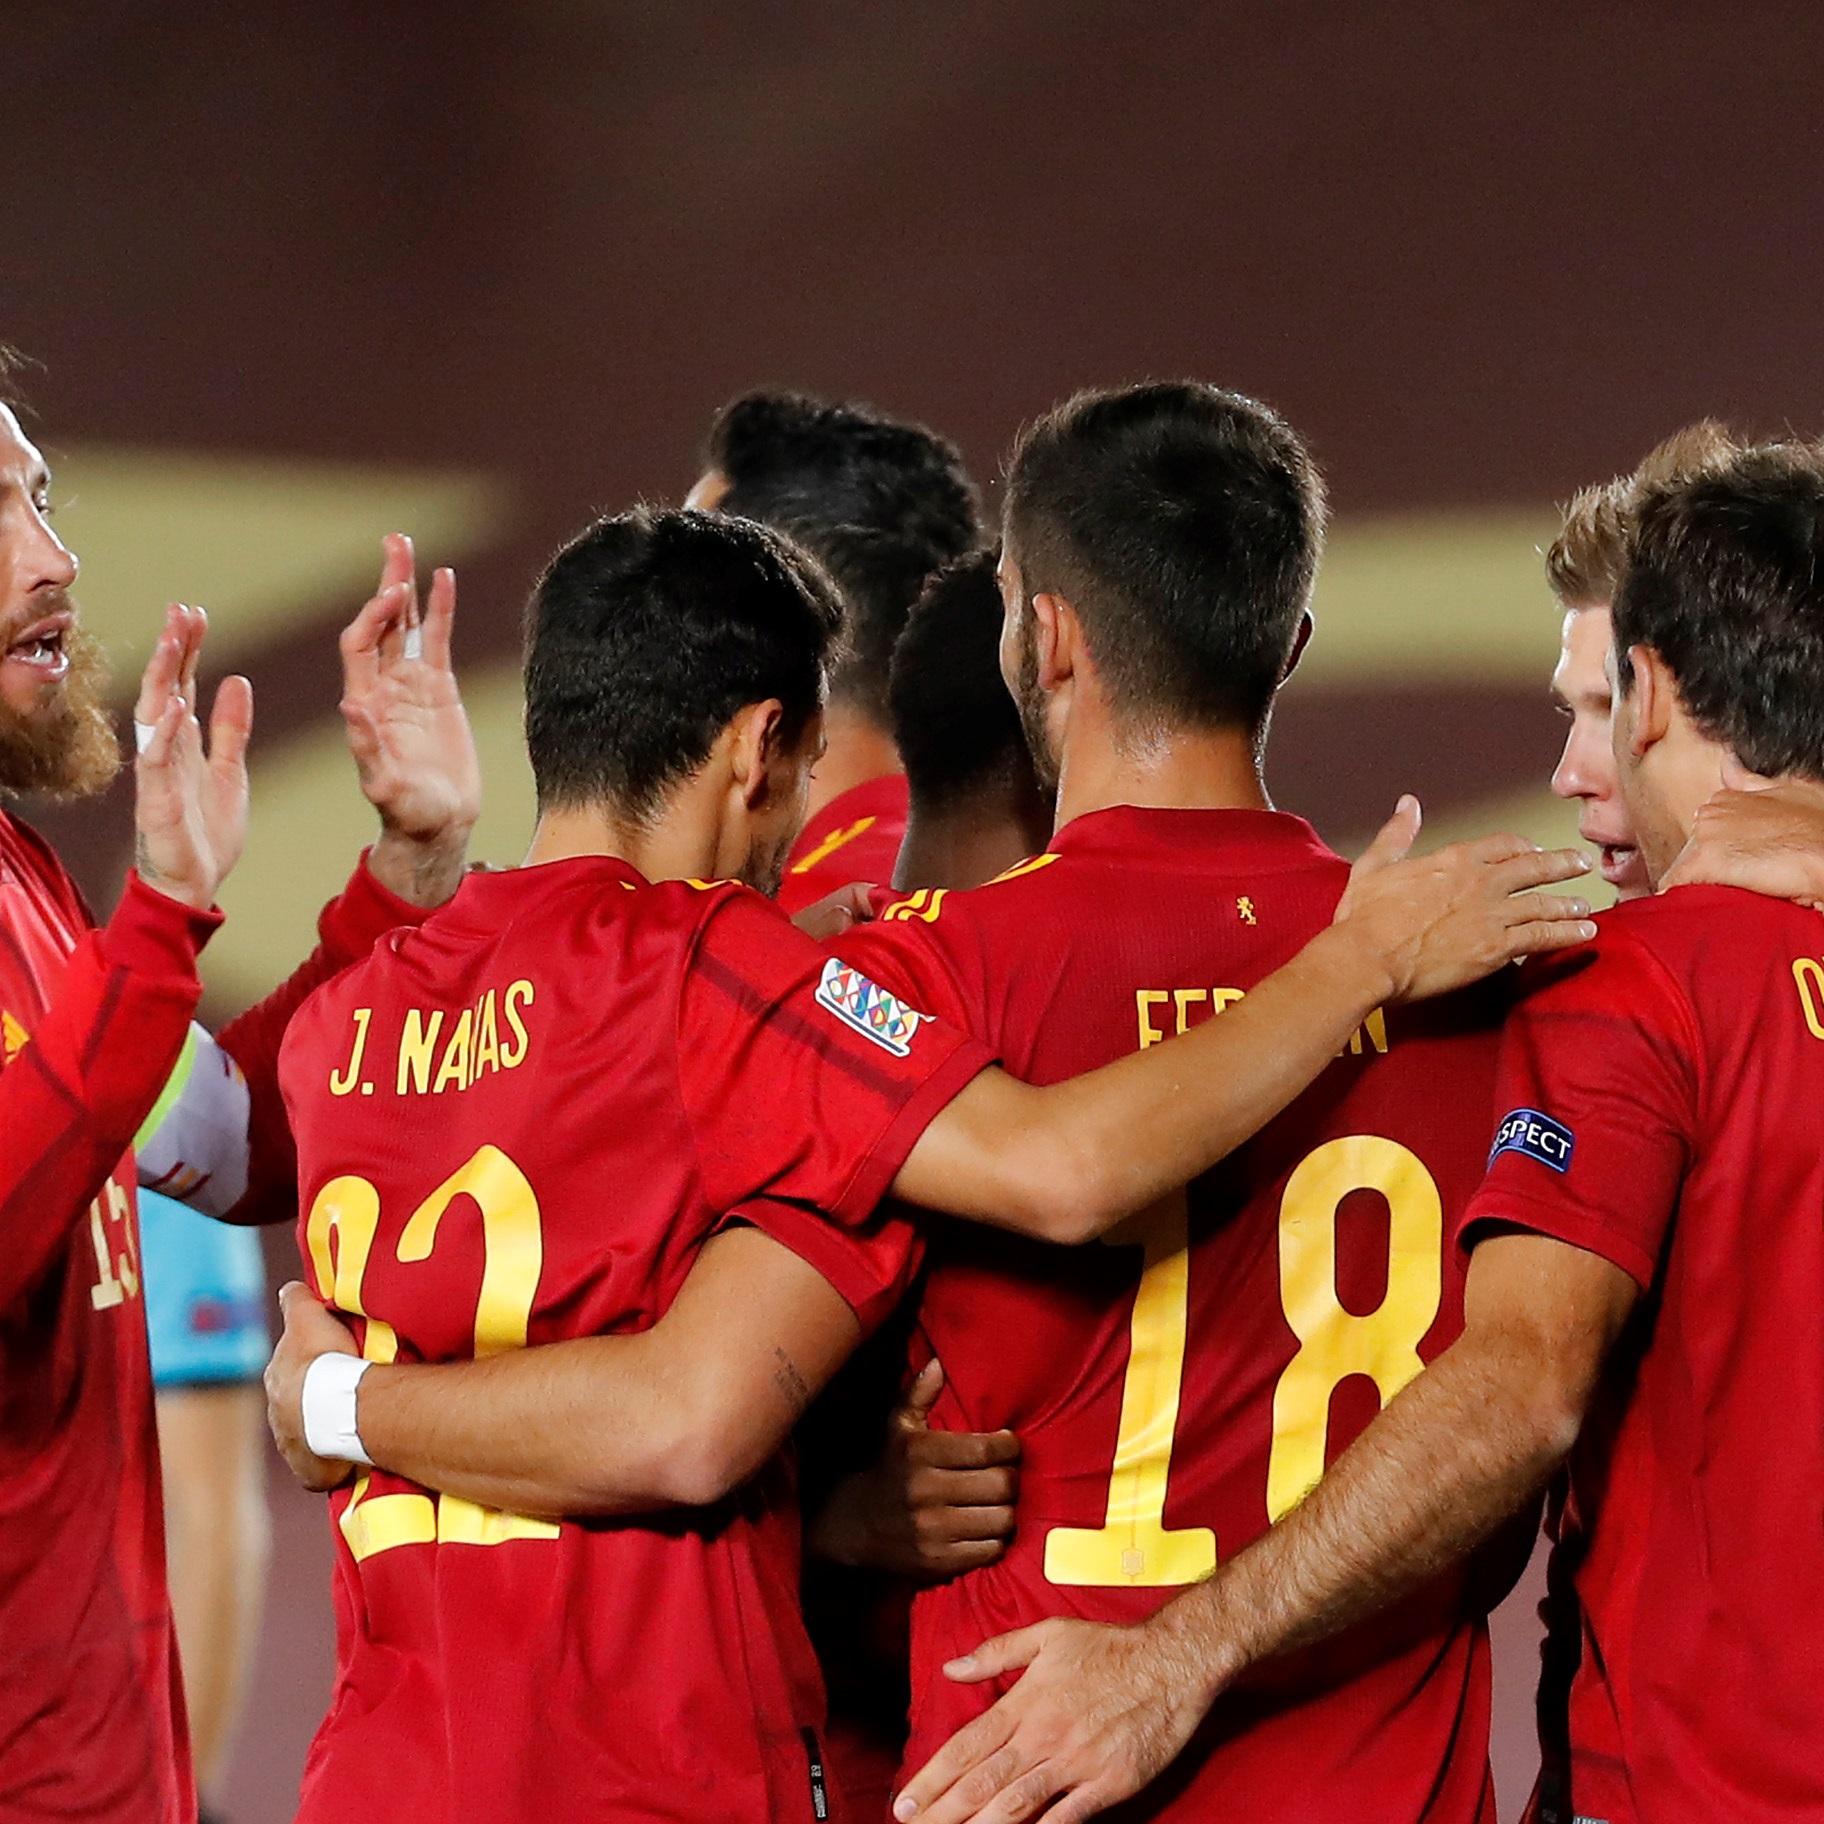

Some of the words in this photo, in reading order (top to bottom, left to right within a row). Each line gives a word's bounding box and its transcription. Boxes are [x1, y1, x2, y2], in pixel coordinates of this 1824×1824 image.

[330, 1008, 374, 1096] J.
[1489, 1119, 1572, 1159] SPECT
[306, 1144, 561, 1562] 22
[1042, 1135, 1444, 1587] 18
